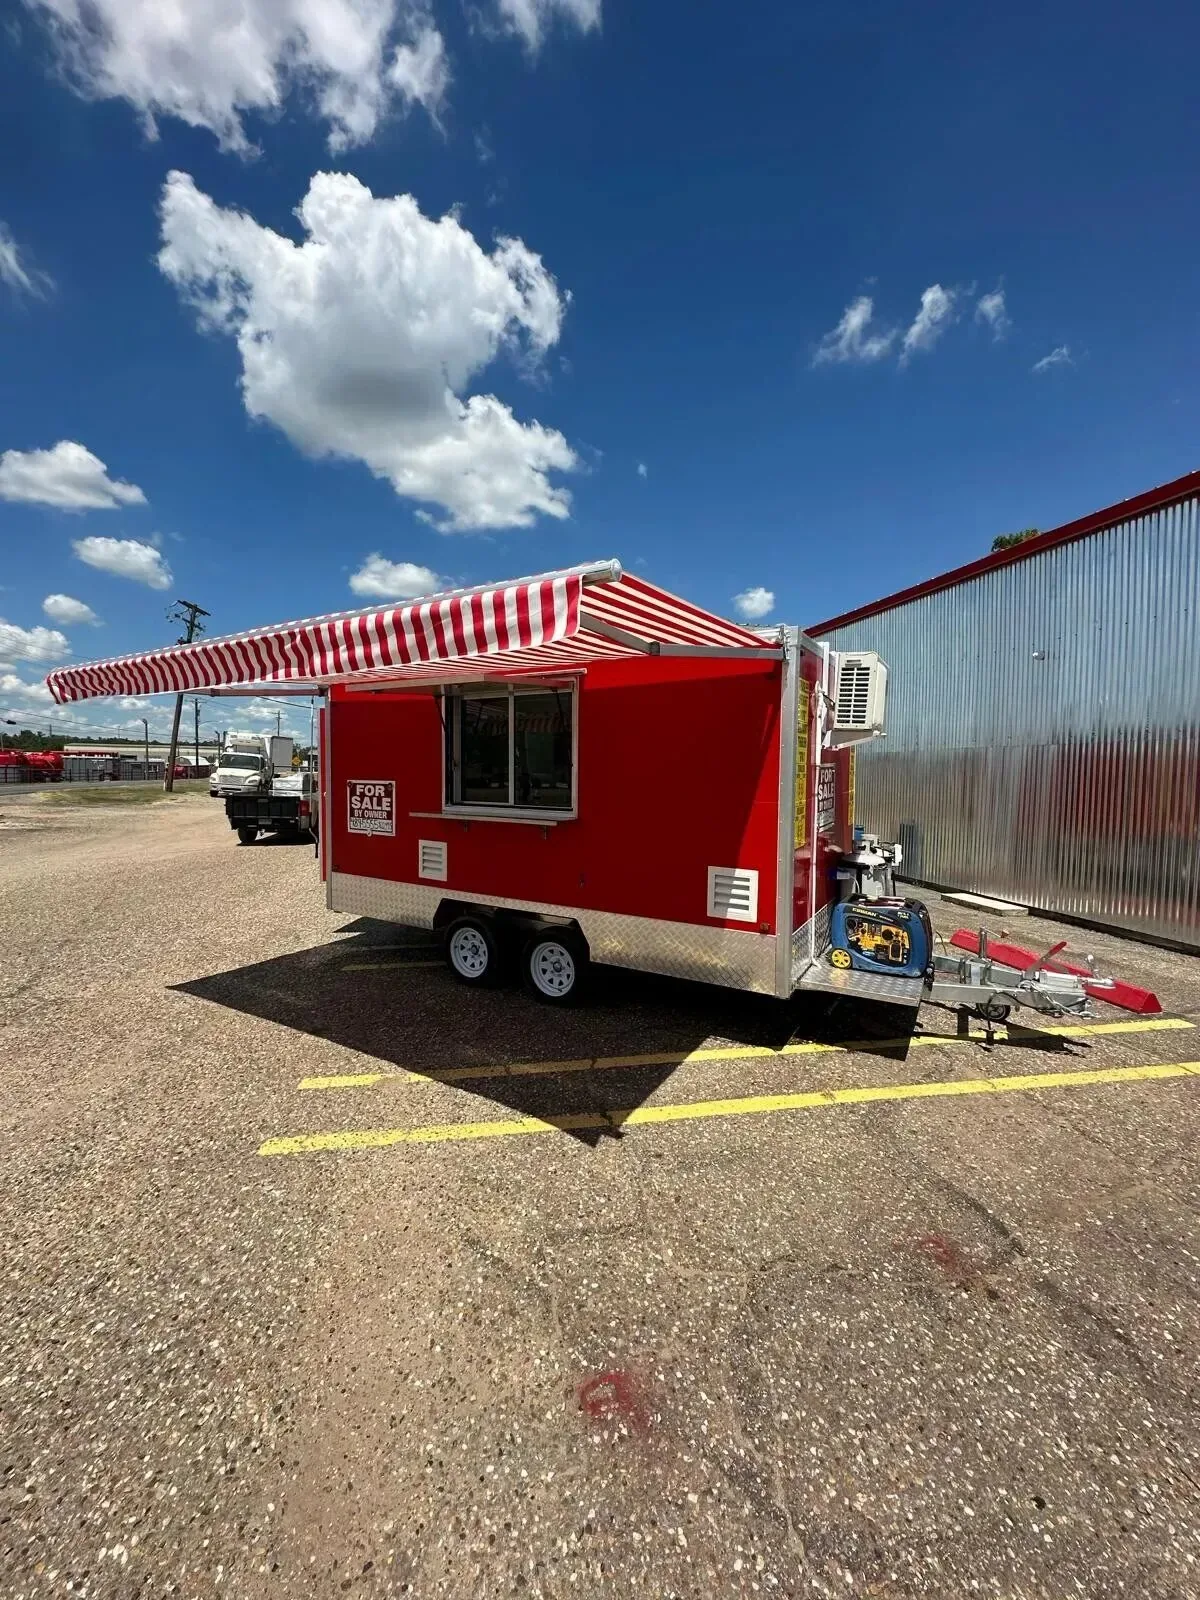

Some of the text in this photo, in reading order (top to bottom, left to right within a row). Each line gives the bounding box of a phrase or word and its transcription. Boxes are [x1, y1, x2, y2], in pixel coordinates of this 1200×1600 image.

[820, 769, 833, 783] FOR
[356, 785, 385, 797] FOR
[818, 783, 834, 800] SALE
[351, 796, 391, 811] SALE
[354, 809, 388, 819] BY OWNER
